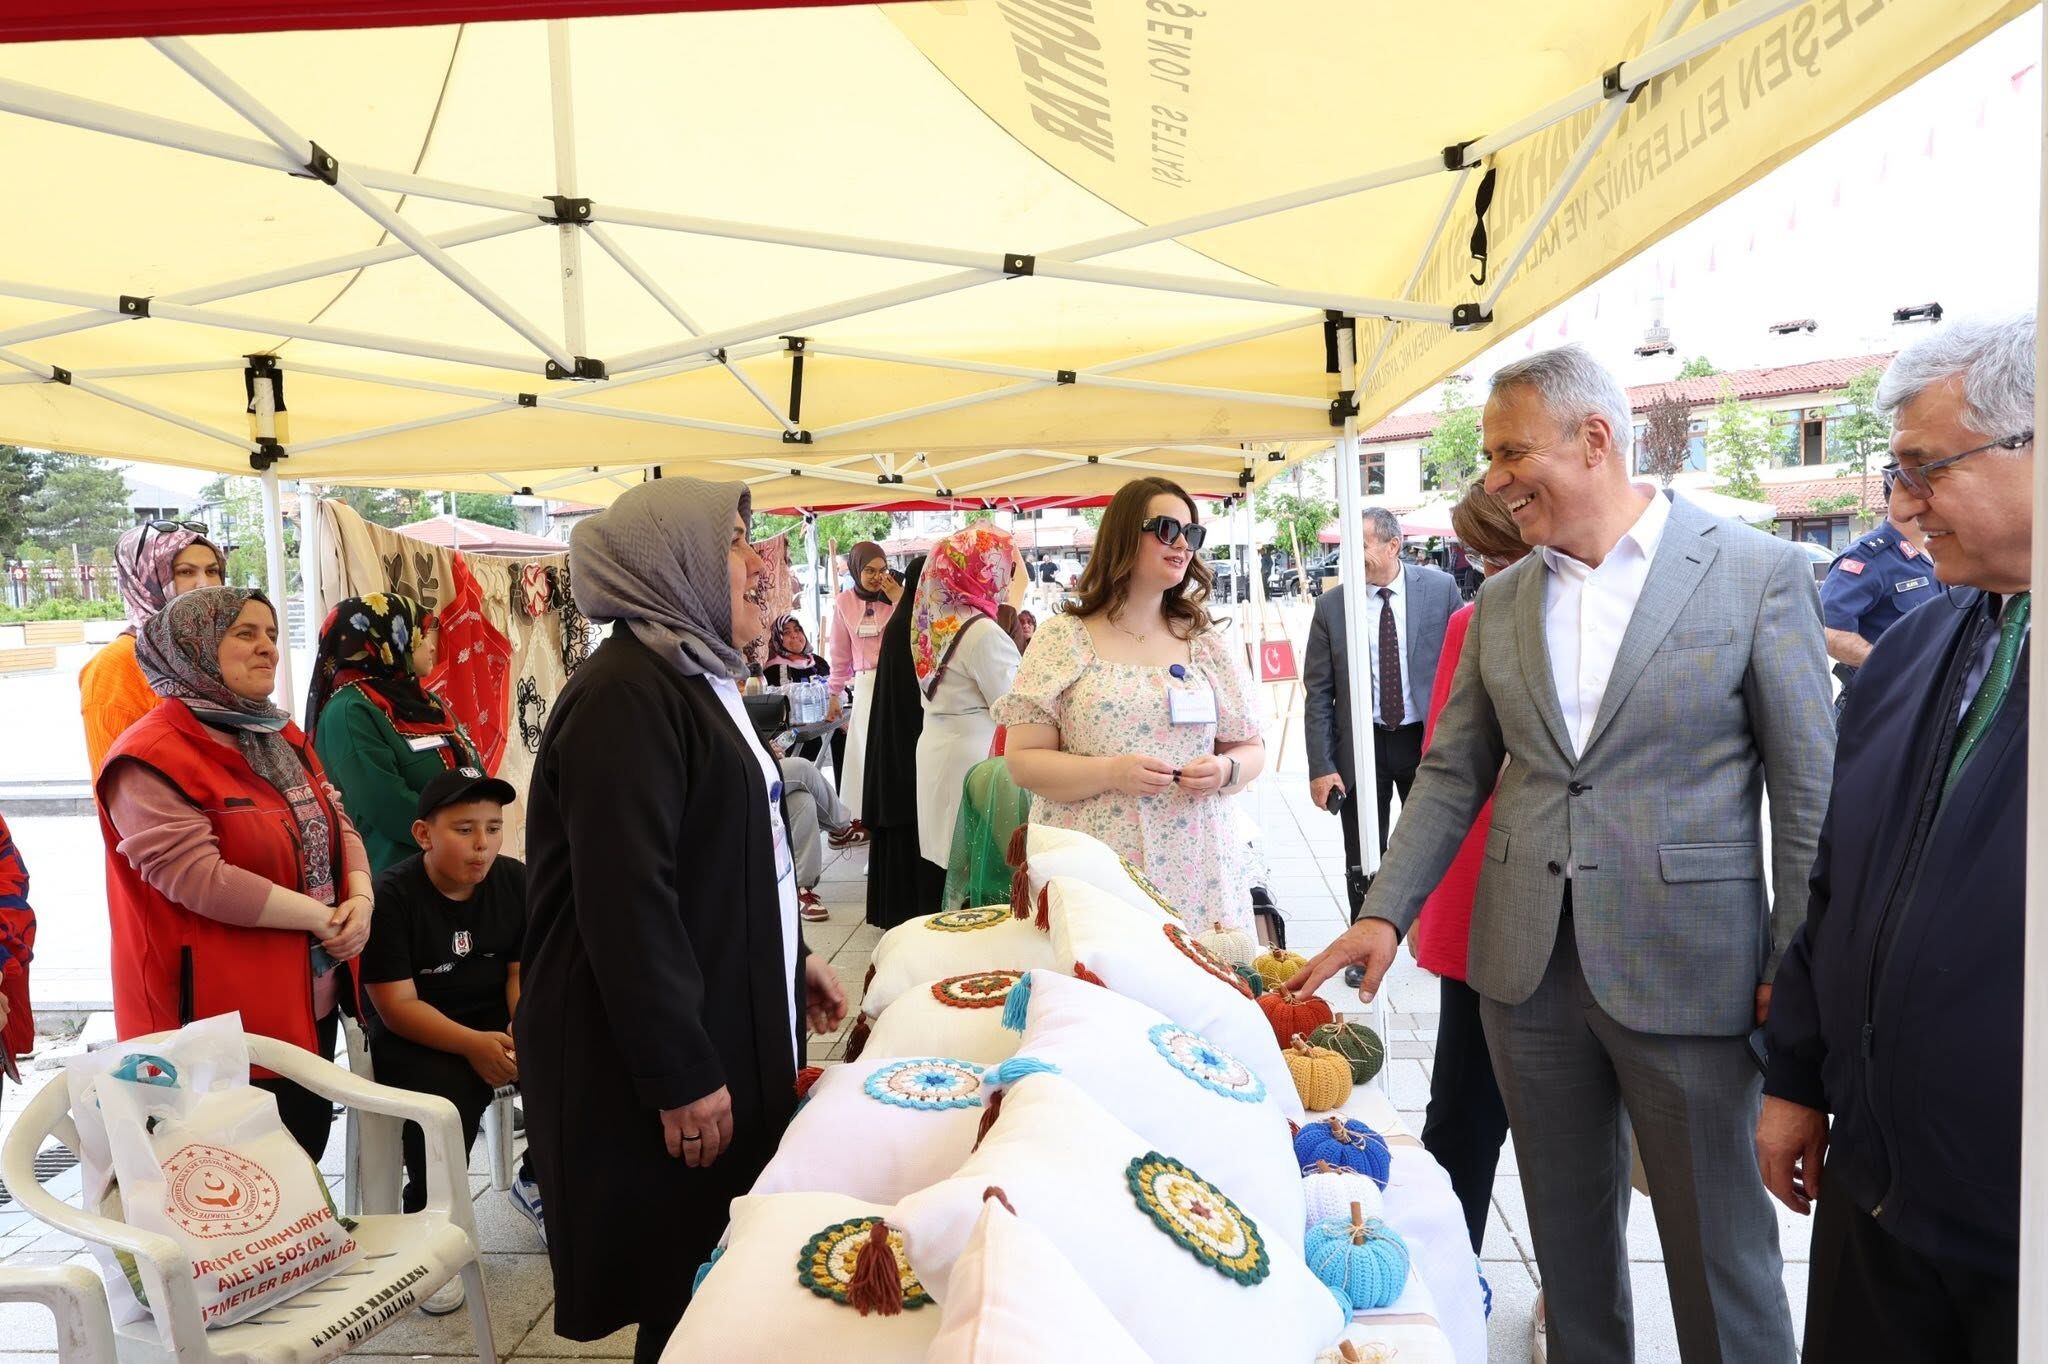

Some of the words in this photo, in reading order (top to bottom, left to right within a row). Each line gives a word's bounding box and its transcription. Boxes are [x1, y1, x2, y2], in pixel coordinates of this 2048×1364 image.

[218, 1267, 254, 1292] AİLE
[252, 1257, 276, 1274] VE
[280, 1239, 356, 1285] BAKANLIĞI
[310, 1305, 369, 1347] KARALAR
